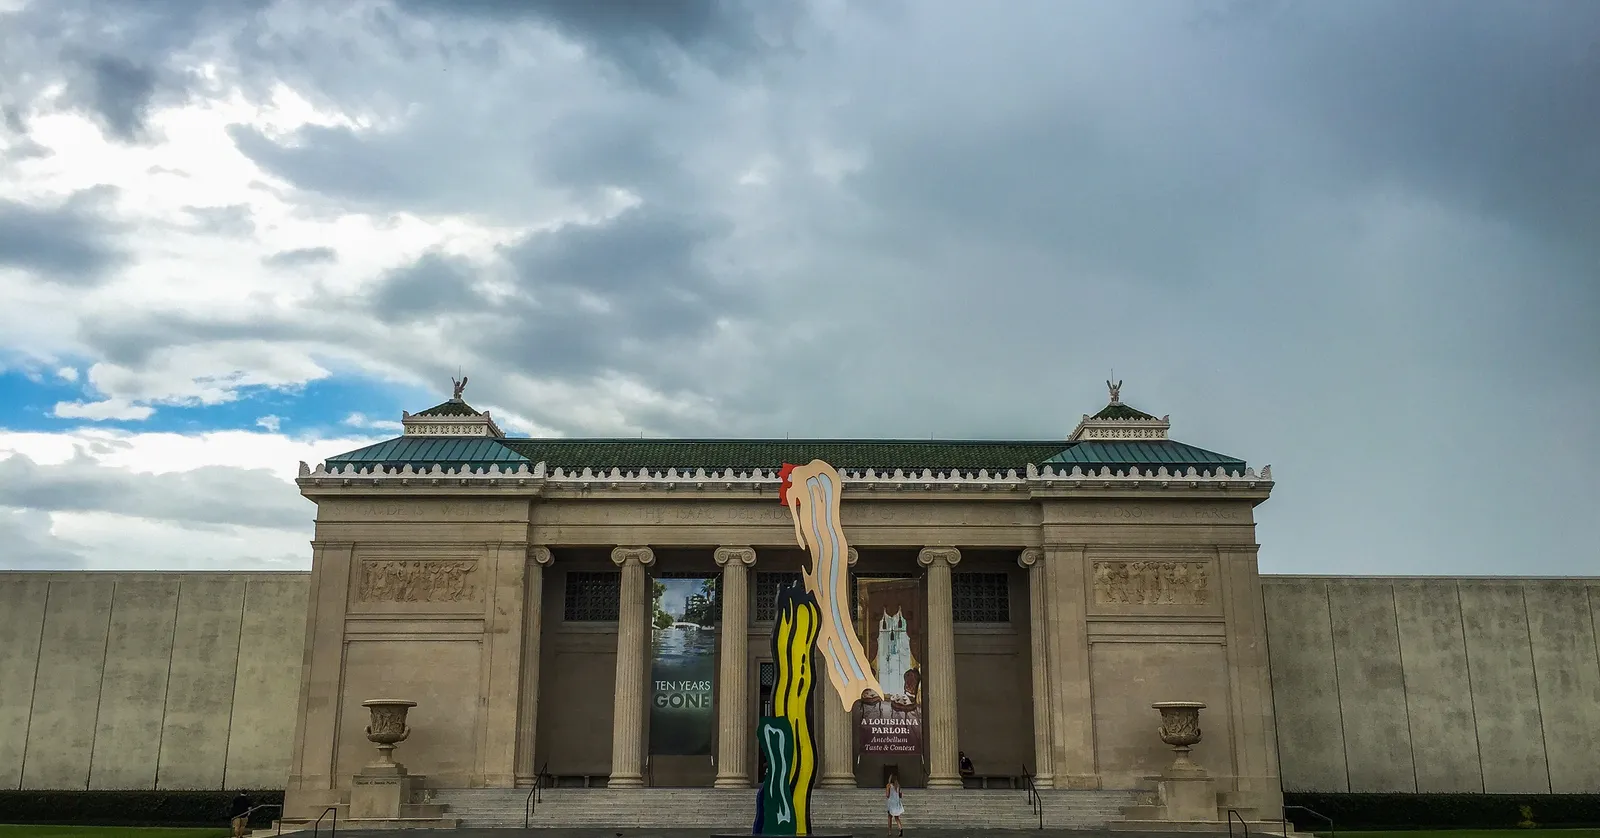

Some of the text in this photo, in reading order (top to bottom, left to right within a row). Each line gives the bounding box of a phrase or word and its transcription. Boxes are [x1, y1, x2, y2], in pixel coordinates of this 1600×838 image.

[655, 681, 711, 691] TEN YEARS
[653, 692, 711, 709] GONE
[869, 718, 919, 726] LOUISIANA
